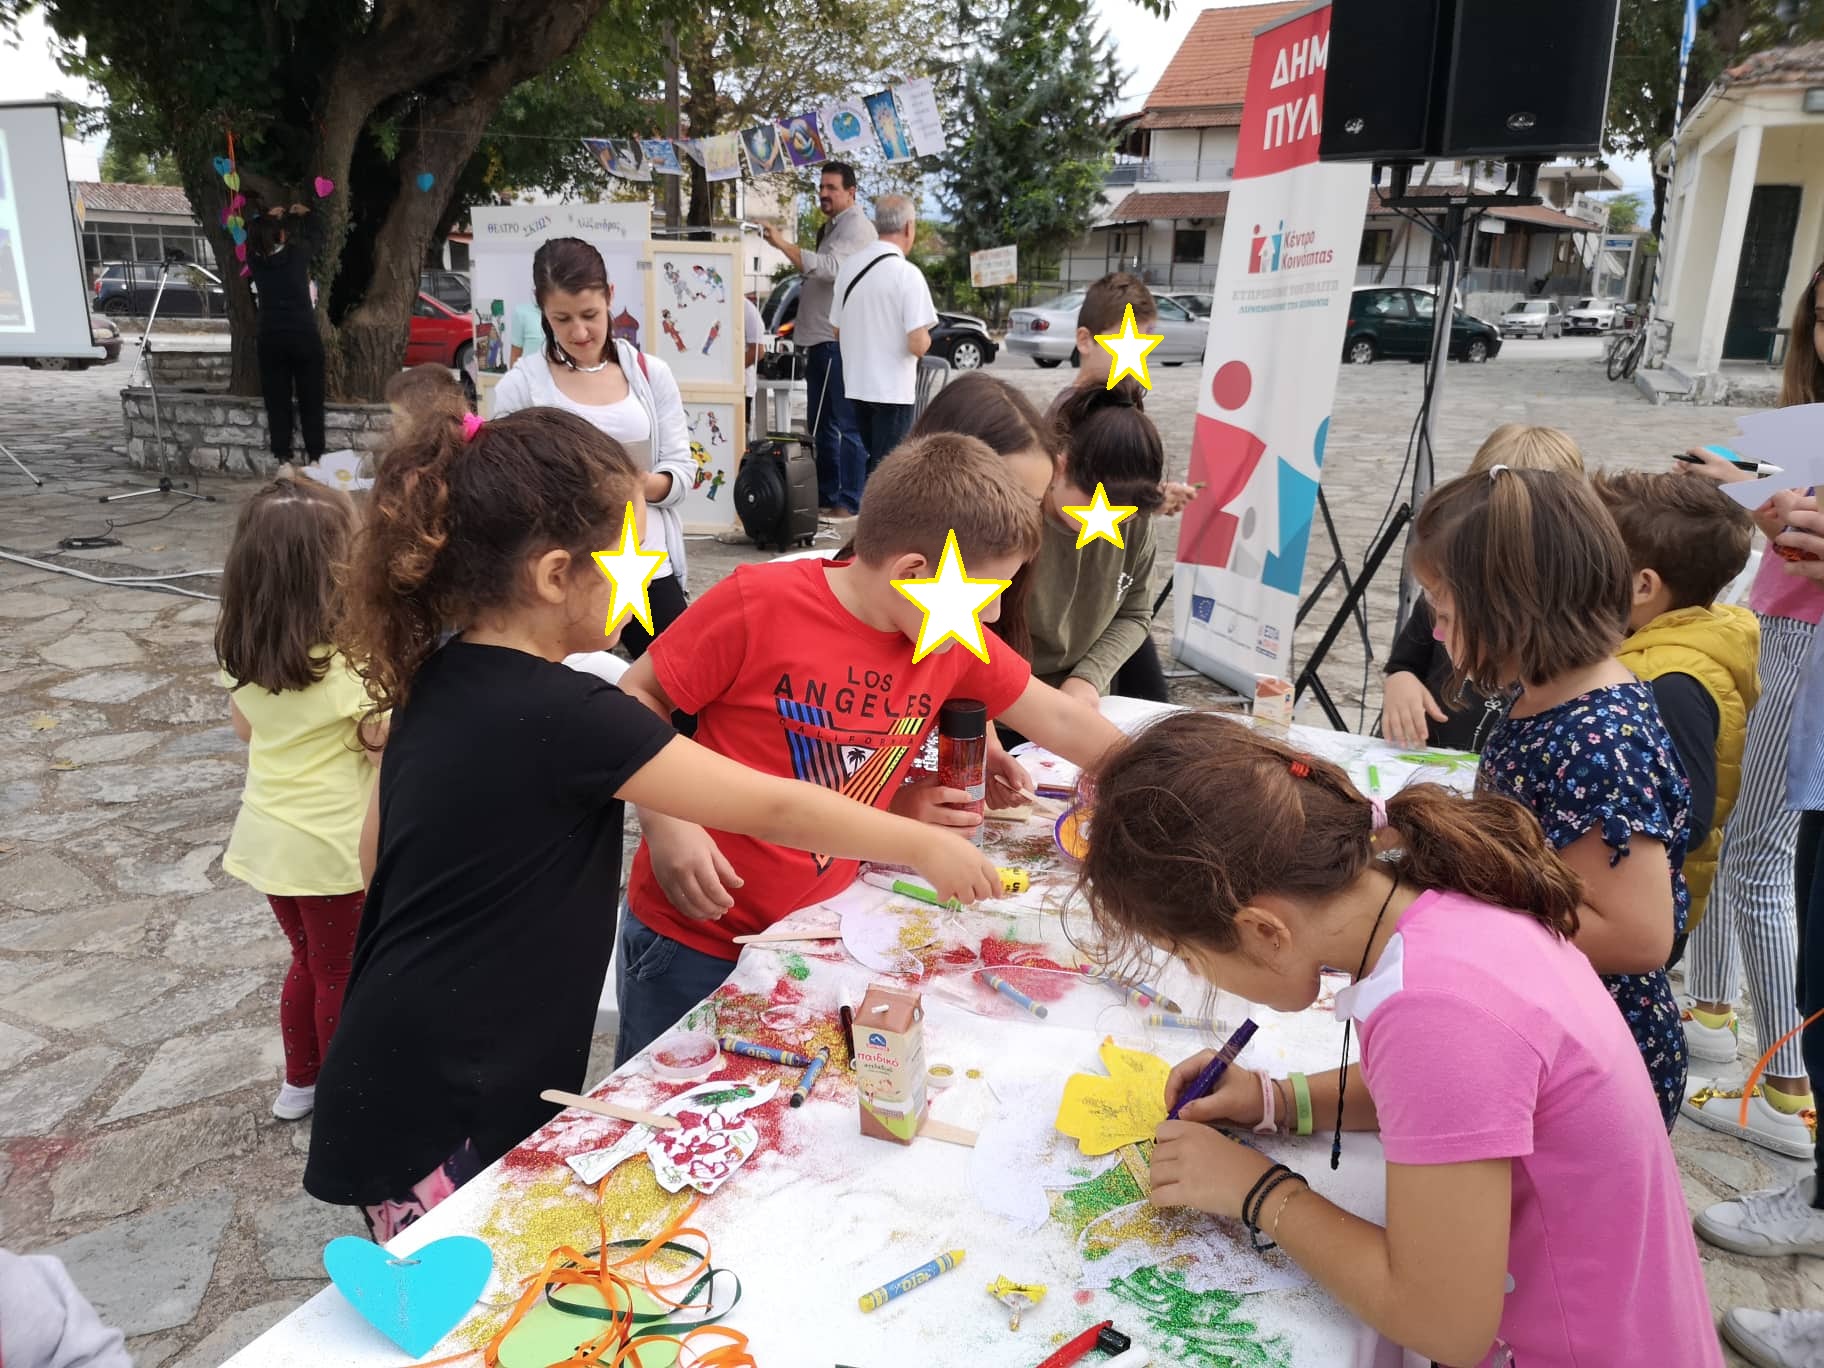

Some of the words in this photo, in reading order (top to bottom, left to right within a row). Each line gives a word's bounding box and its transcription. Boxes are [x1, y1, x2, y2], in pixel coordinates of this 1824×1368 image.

[1270, 30, 1330, 90] ΔΗΜ
[1263, 94, 1323, 150] ΠΥΛ
[487, 223, 519, 233] ΘΕΑΤΡΟ
[1284, 230, 1316, 250] Κέντρο
[848, 665, 893, 692] LOS
[774, 673, 932, 719] ANGELES
[857, 1052, 900, 1068] παιδικό
